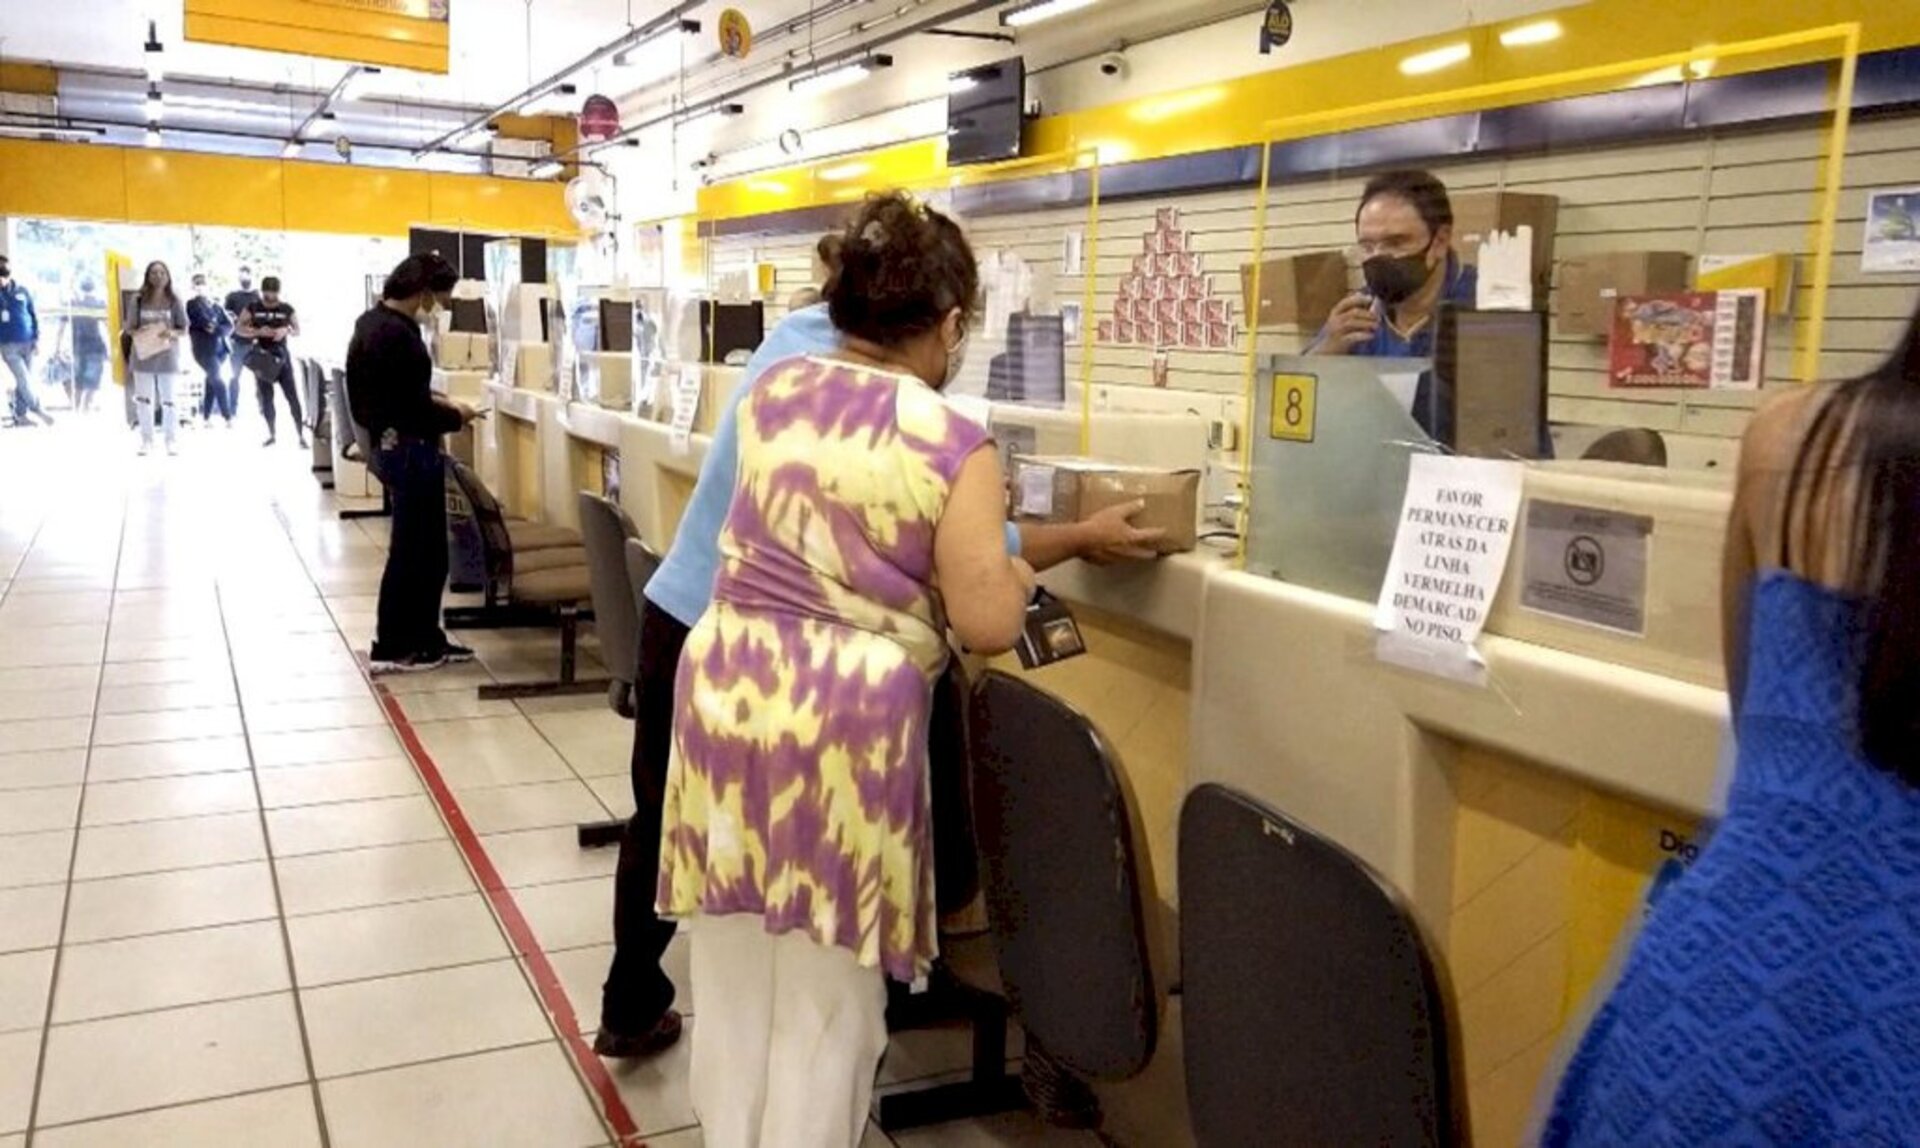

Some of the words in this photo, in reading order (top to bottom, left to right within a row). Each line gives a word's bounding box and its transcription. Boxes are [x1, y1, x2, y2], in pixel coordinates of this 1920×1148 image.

[1285, 387, 1302, 427] 8
[1436, 487, 1483, 507] FAVOR
[1407, 506, 1509, 533] PERMANECER
[1418, 531, 1463, 550] ATRAS
[1465, 537, 1488, 555] DA
[1424, 553, 1470, 576] LINHA
[1403, 572, 1485, 602] VERMELHA
[1393, 592, 1478, 622] DEMARCAD
[1403, 616, 1425, 635] NO
[1660, 829, 1699, 868] Dig
